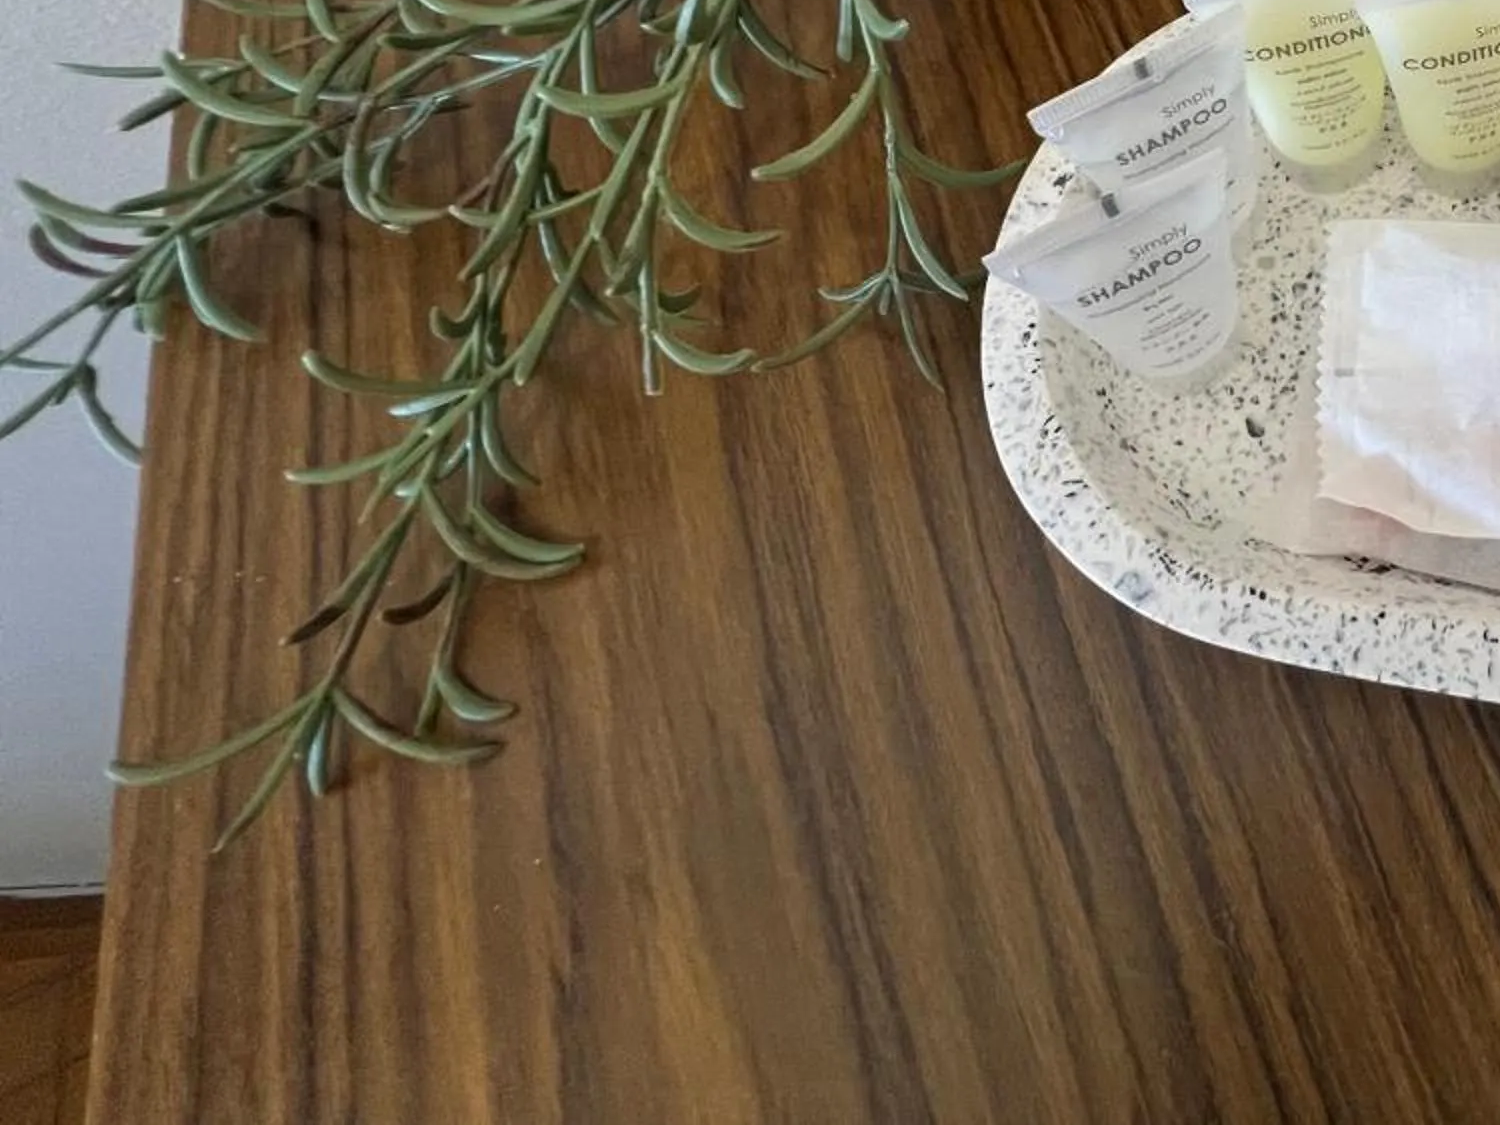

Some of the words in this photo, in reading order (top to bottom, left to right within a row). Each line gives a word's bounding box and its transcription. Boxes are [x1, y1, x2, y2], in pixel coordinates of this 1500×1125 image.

[1309, 9, 1361, 29] Simpl
[1162, 82, 1216, 119] Simply
[1115, 98, 1228, 167] SHAMPOO
[1128, 222, 1189, 262] Simply
[1076, 237, 1203, 309] SHAMPOO
